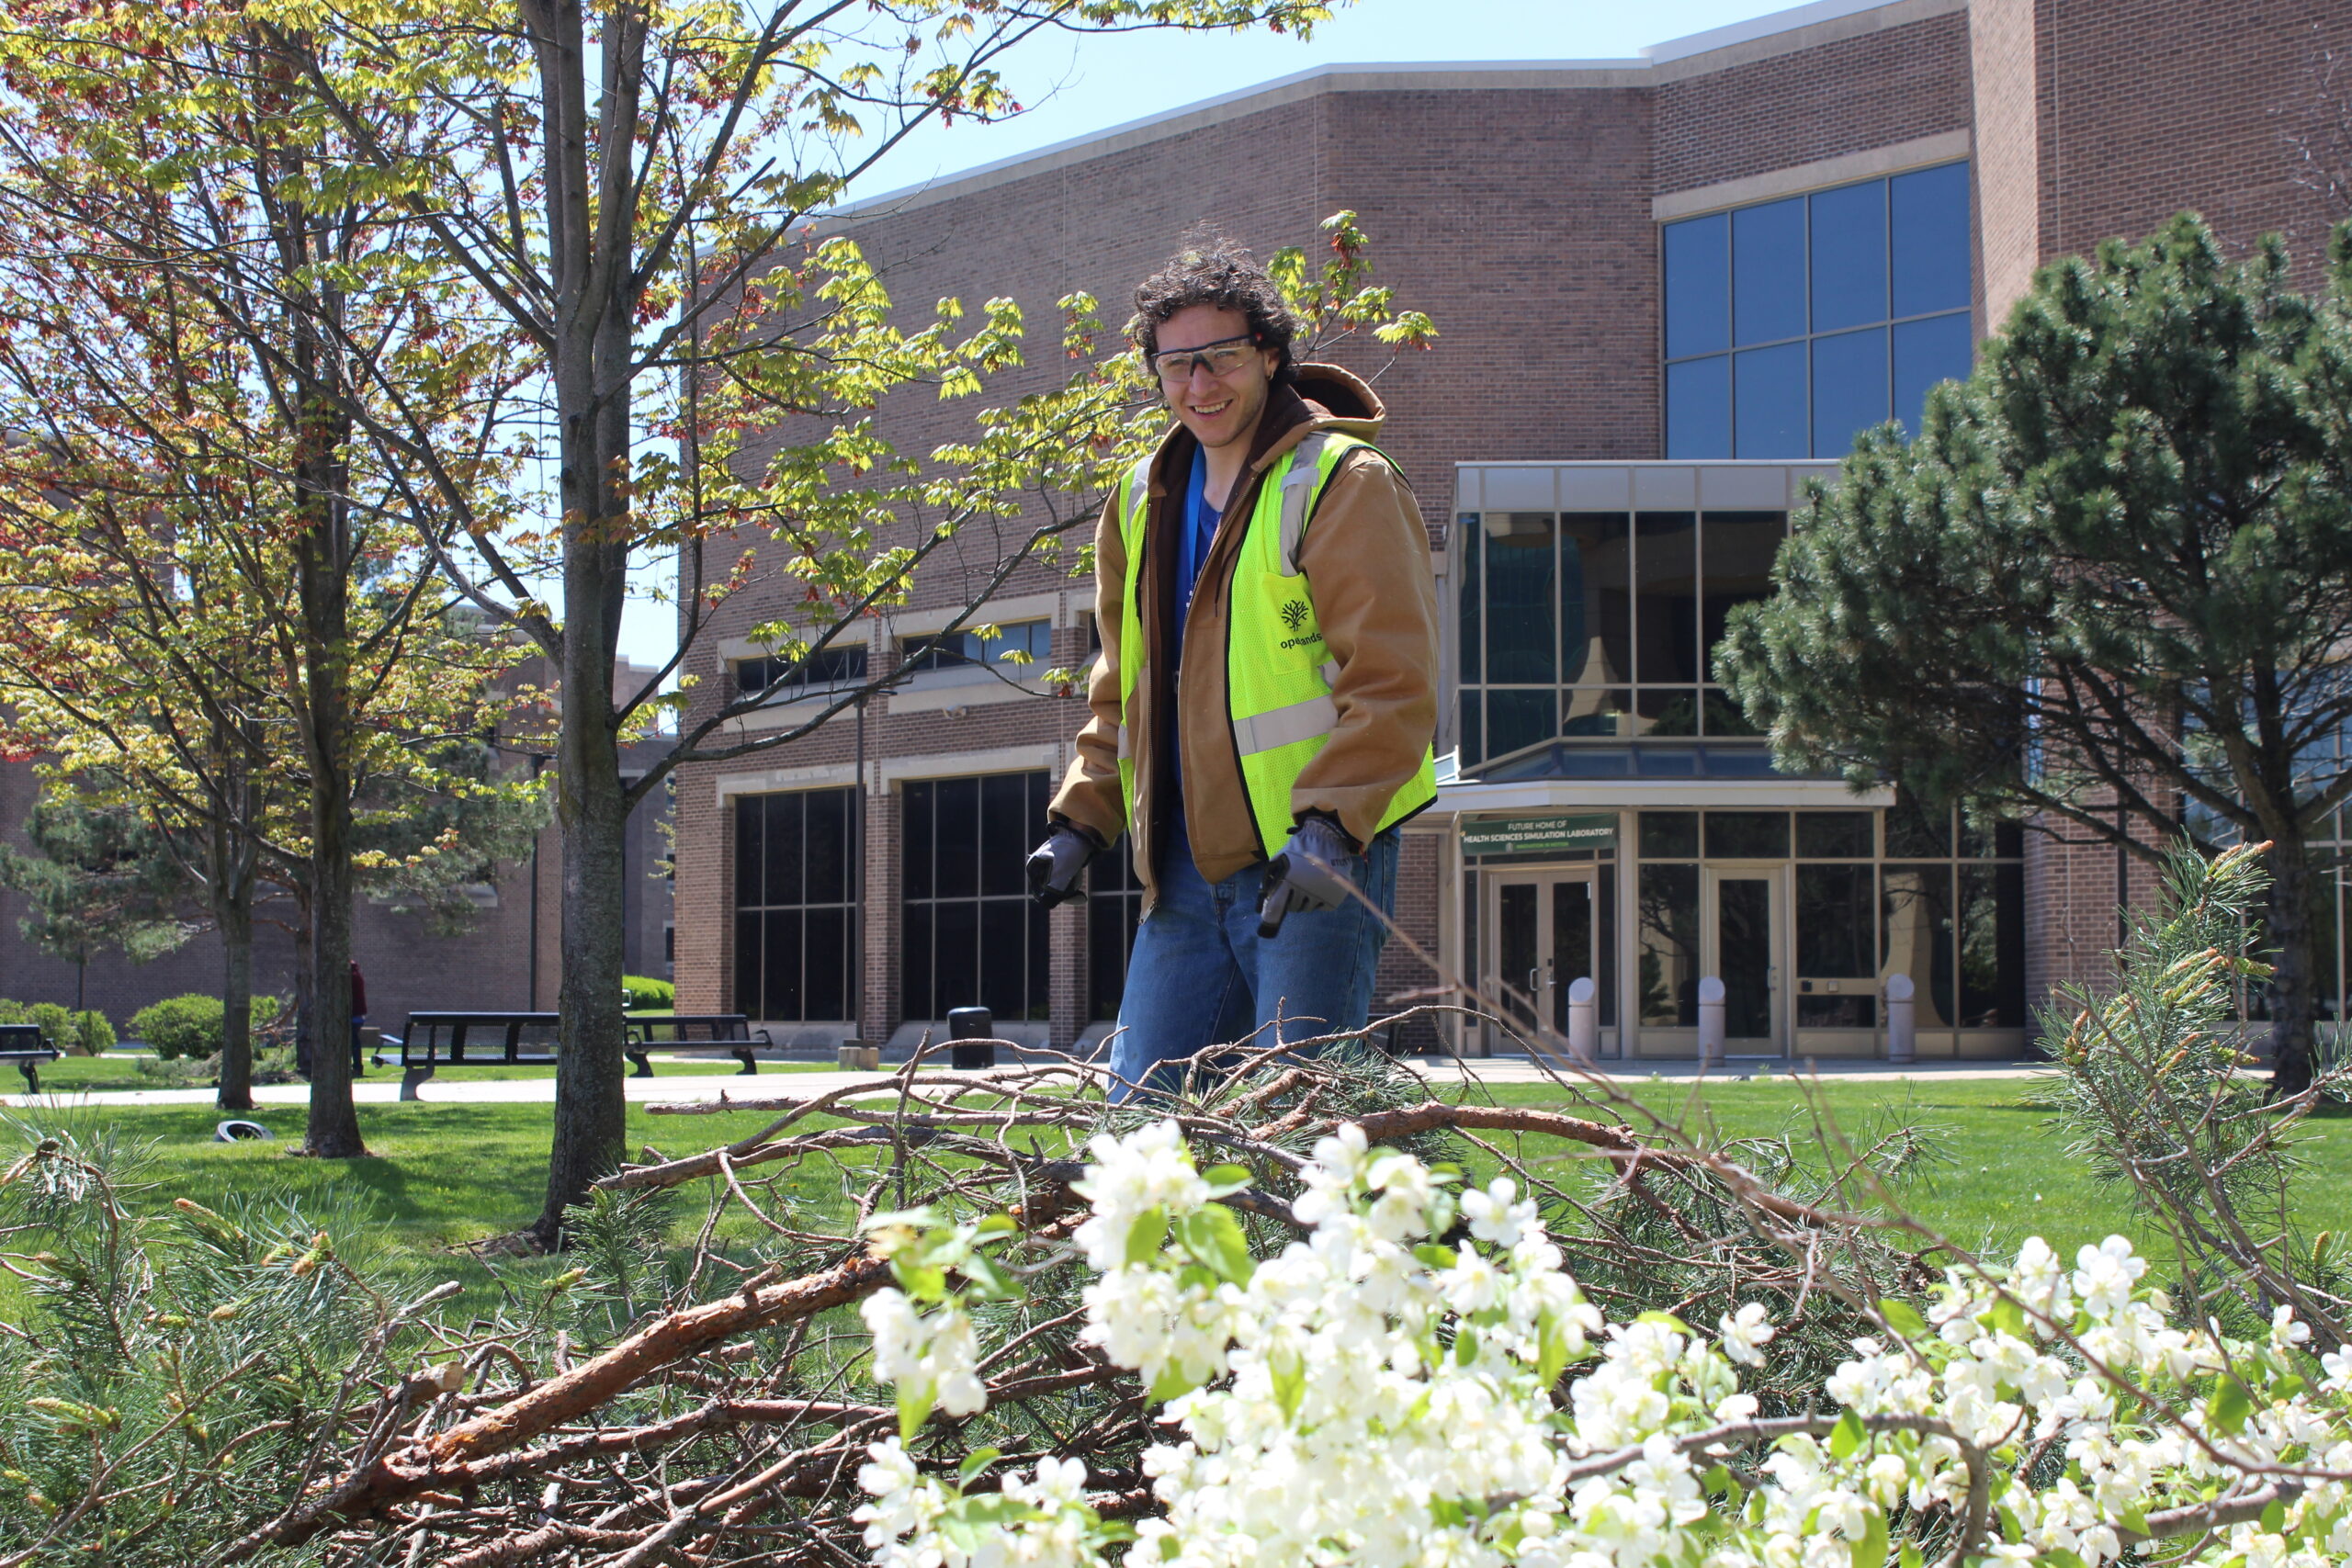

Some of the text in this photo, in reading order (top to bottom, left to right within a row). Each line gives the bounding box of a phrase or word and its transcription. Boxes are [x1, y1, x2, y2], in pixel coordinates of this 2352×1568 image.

[1508, 820, 1567, 830] FUTURE HOME OF
[1464, 828, 1614, 843] HEALTH SCIENCES SIMULATION LABORATORY
